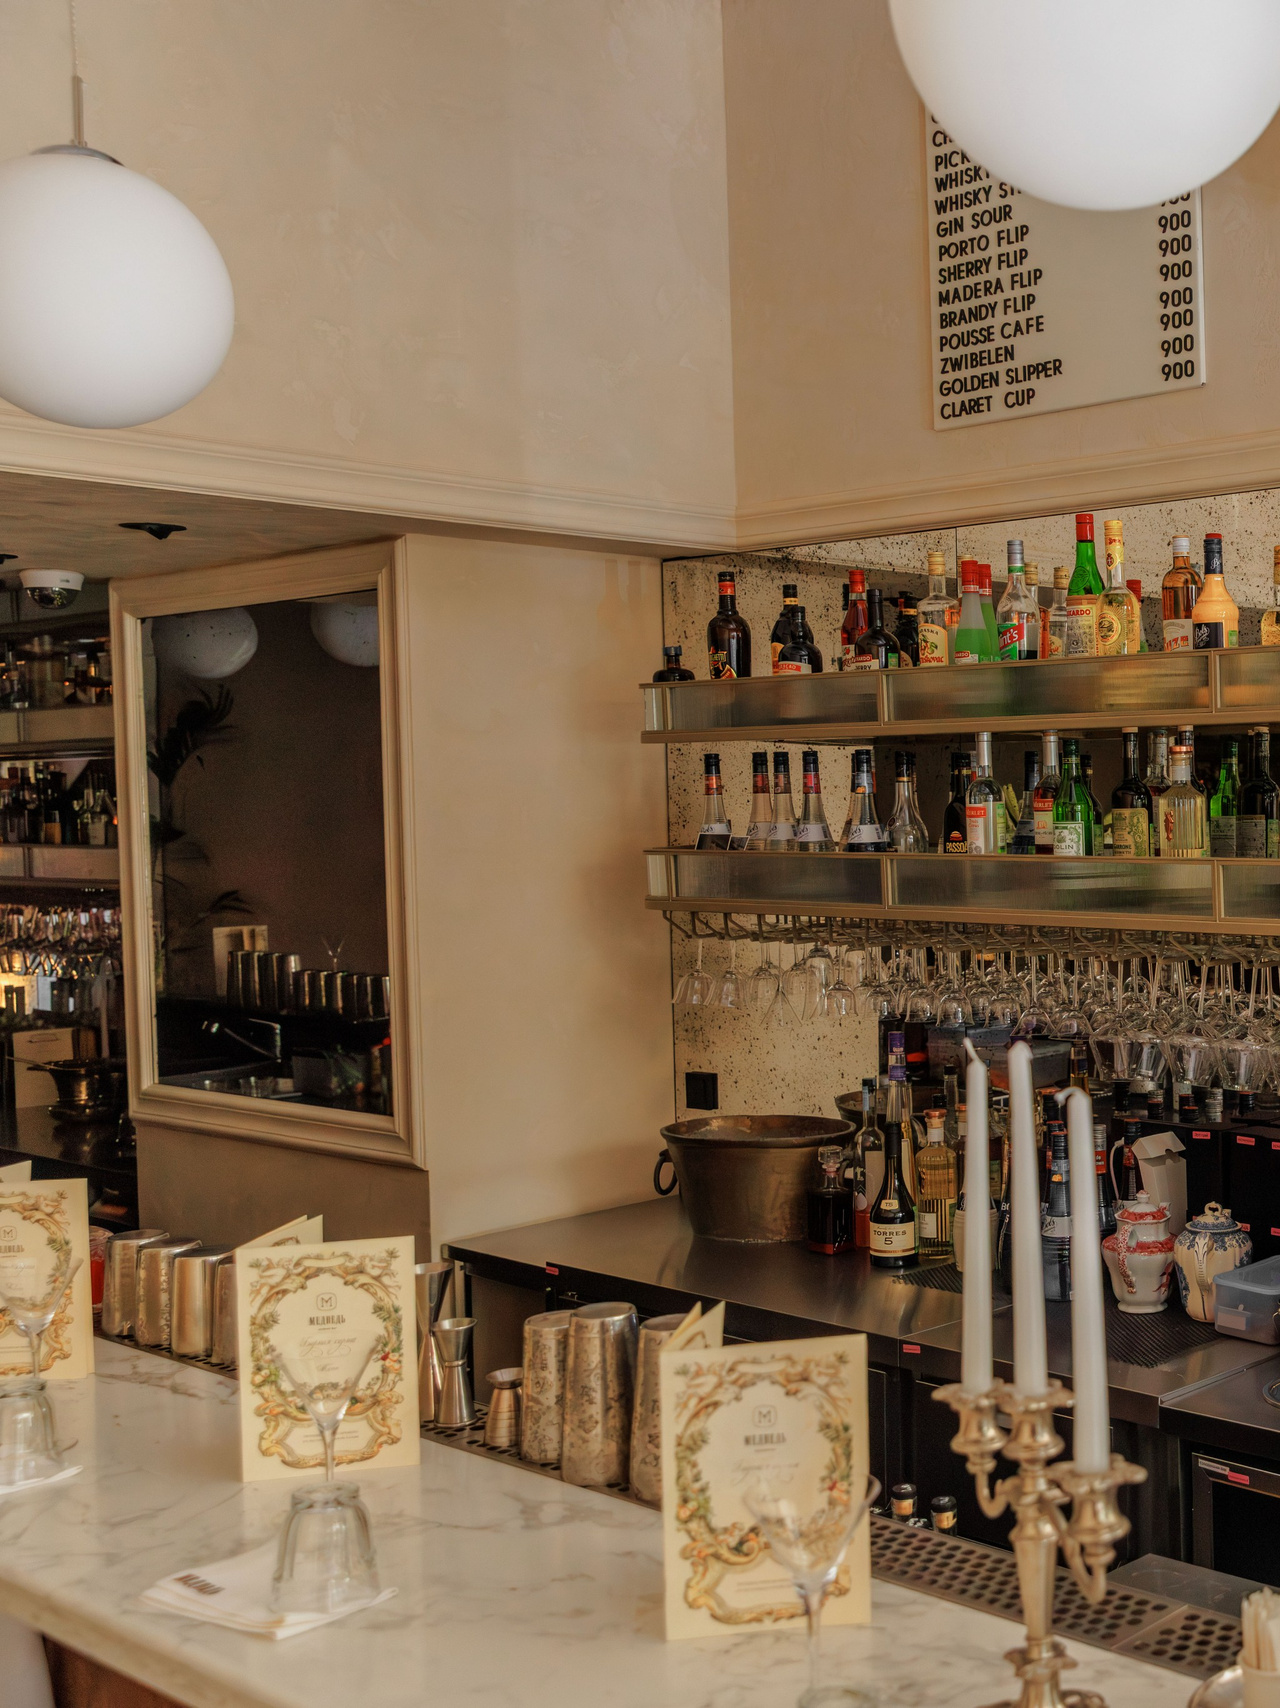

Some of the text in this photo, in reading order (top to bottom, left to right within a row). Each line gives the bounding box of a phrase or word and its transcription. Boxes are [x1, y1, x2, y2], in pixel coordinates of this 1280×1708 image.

[934, 185, 993, 215] WHISKY
[936, 204, 1013, 238] GIN SOUR
[1158, 210, 1192, 234] 900
[939, 224, 1029, 261] PORTO FLIP
[1159, 234, 1192, 257] 900
[938, 248, 1028, 285] SHERRY FLIP
[1159, 260, 1192, 282] 900
[938, 268, 1043, 307] MADERA FLIP
[1159, 287, 1193, 309] 900
[940, 293, 1036, 329] BRANDY FLIP
[1160, 308, 1194, 331] 900
[940, 315, 1045, 352] POUSSE CAFE
[1160, 334, 1194, 358] 900
[940, 344, 1015, 375] ZWIBELEN
[1161, 360, 1195, 382] 900
[939, 358, 1063, 397] GOLDEN SLIPPER
[940, 388, 1036, 420] CLARET CUP
[873, 1229, 907, 1237] TORRES
[884, 1237, 893, 1246] 5
